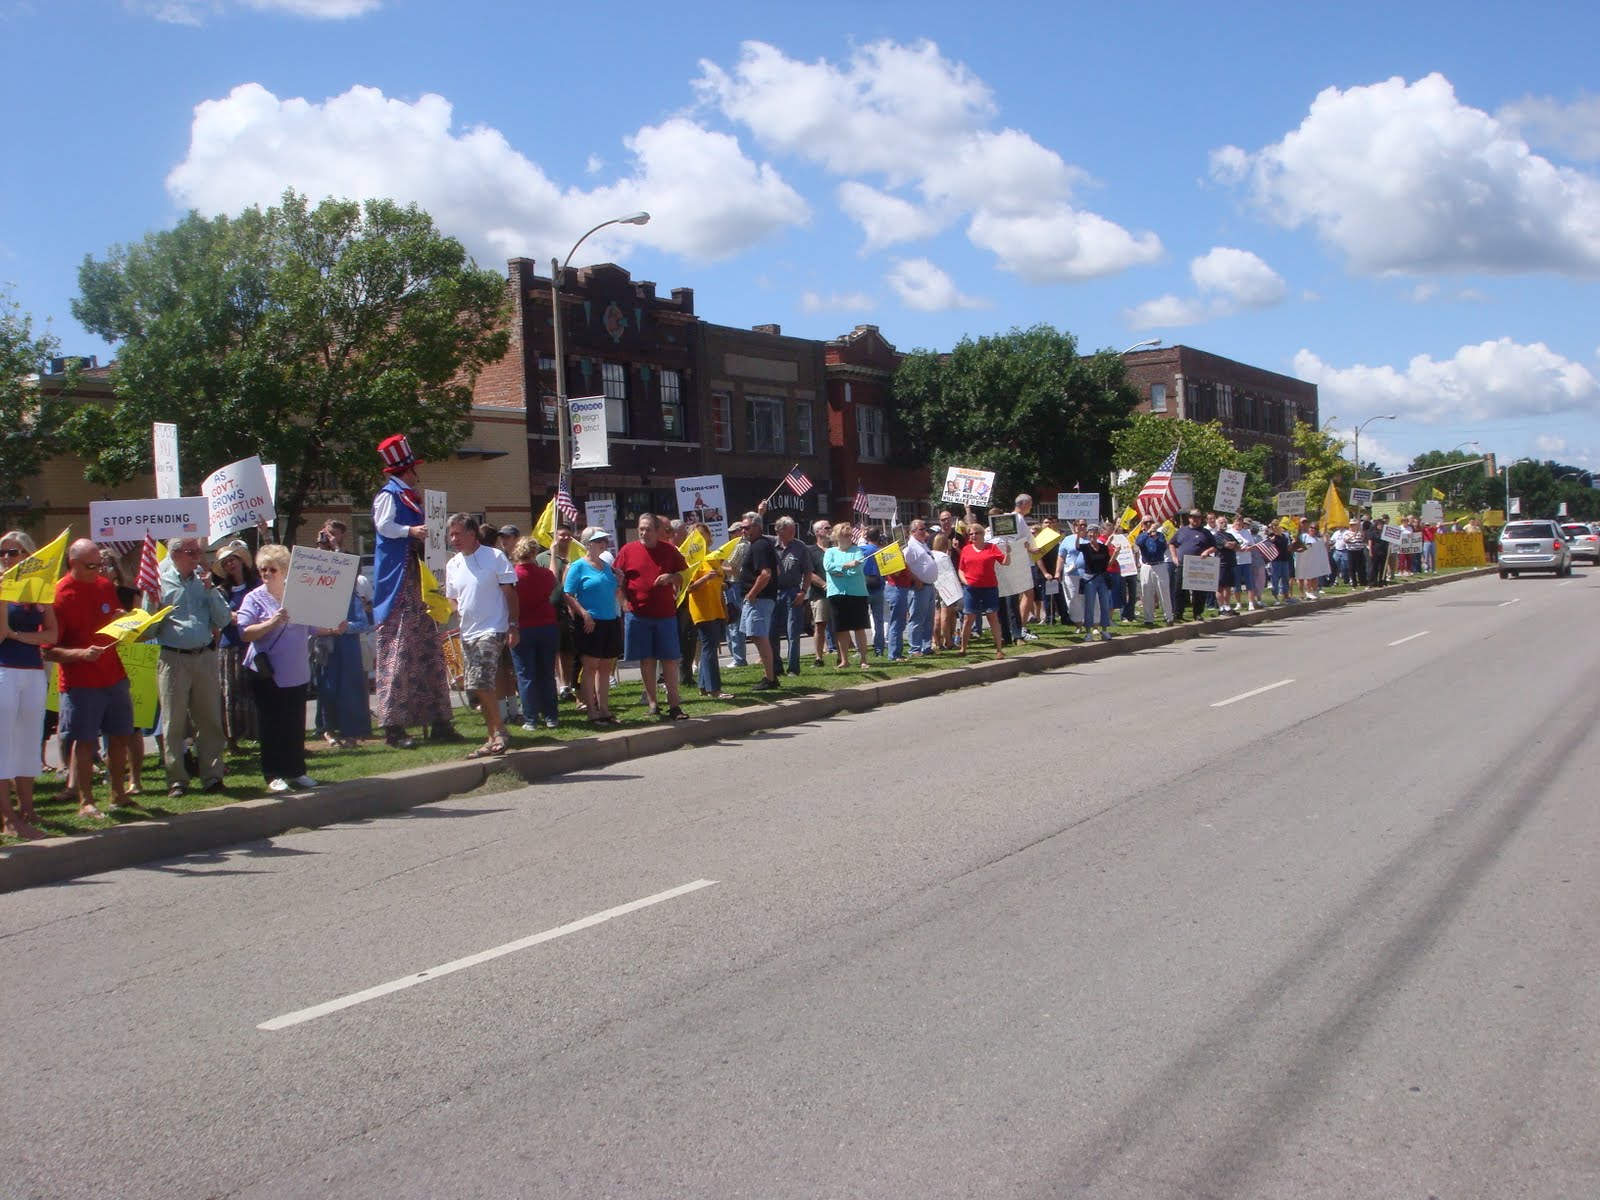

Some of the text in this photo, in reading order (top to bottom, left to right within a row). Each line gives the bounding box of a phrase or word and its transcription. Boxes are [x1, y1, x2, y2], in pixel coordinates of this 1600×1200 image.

[214, 471, 227, 484] AS
[212, 479, 239, 498] GOVT.
[213, 489, 245, 511] GROWS
[768, 495, 805, 511] ALOMINO
[103, 513, 190, 526] STOP SPENDING
[208, 496, 265, 527] CORRUPTION
[218, 510, 257, 531] FLOWS
[317, 575, 337, 590] NO!
